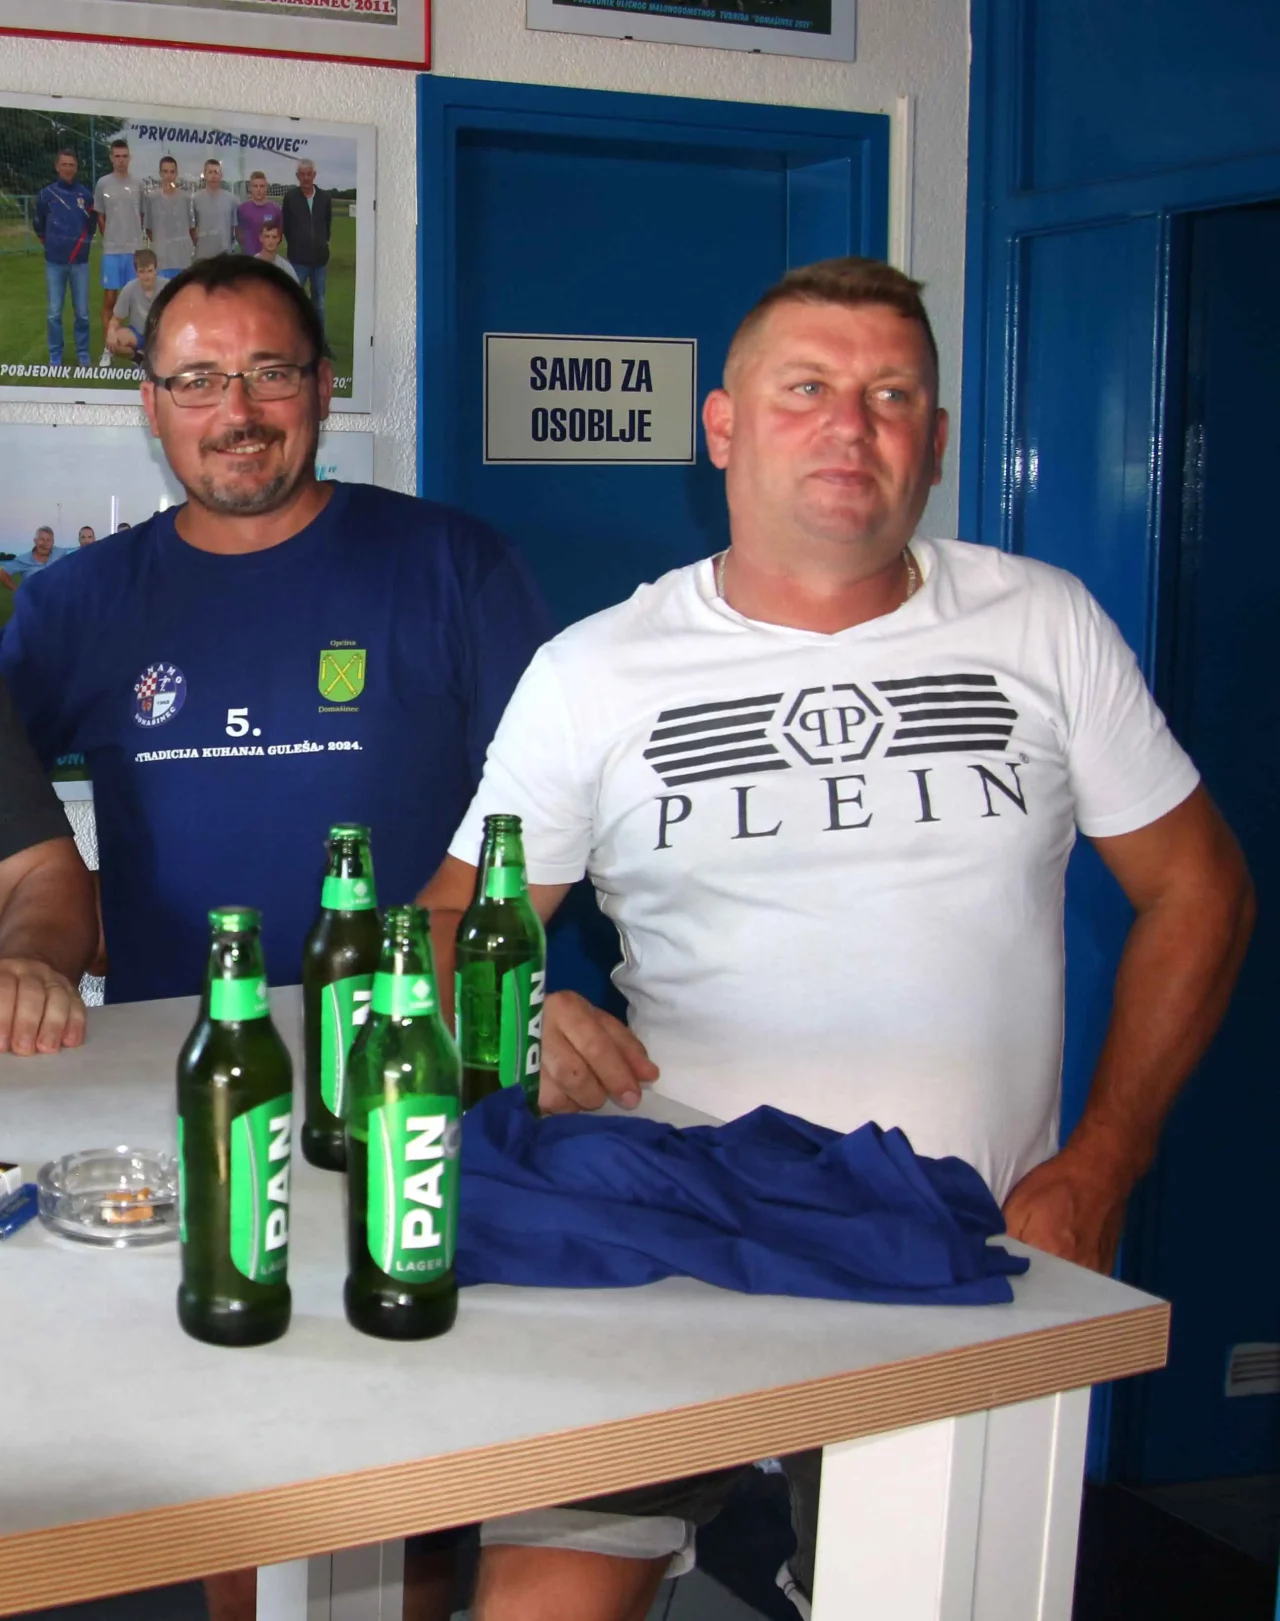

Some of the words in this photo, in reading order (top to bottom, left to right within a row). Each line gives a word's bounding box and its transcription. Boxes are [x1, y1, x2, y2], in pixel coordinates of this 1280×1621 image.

[355, 0, 395, 13] 2011.
[131, 124, 308, 153] "PRVOMAJSKA-BOKOVEC"
[0, 364, 71, 379] POBJEDNIK
[530, 356, 611, 392] SAMO
[621, 359, 653, 392] ZA
[531, 407, 652, 443] OSOBLJE
[225, 707, 261, 738] 5.
[202, 745, 265, 758] KUHANJA
[328, 741, 363, 752] 2024.
[653, 762, 1029, 851] PLEIN
[401, 1114, 447, 1250] PAN
[395, 1258, 443, 1272] LAGER
